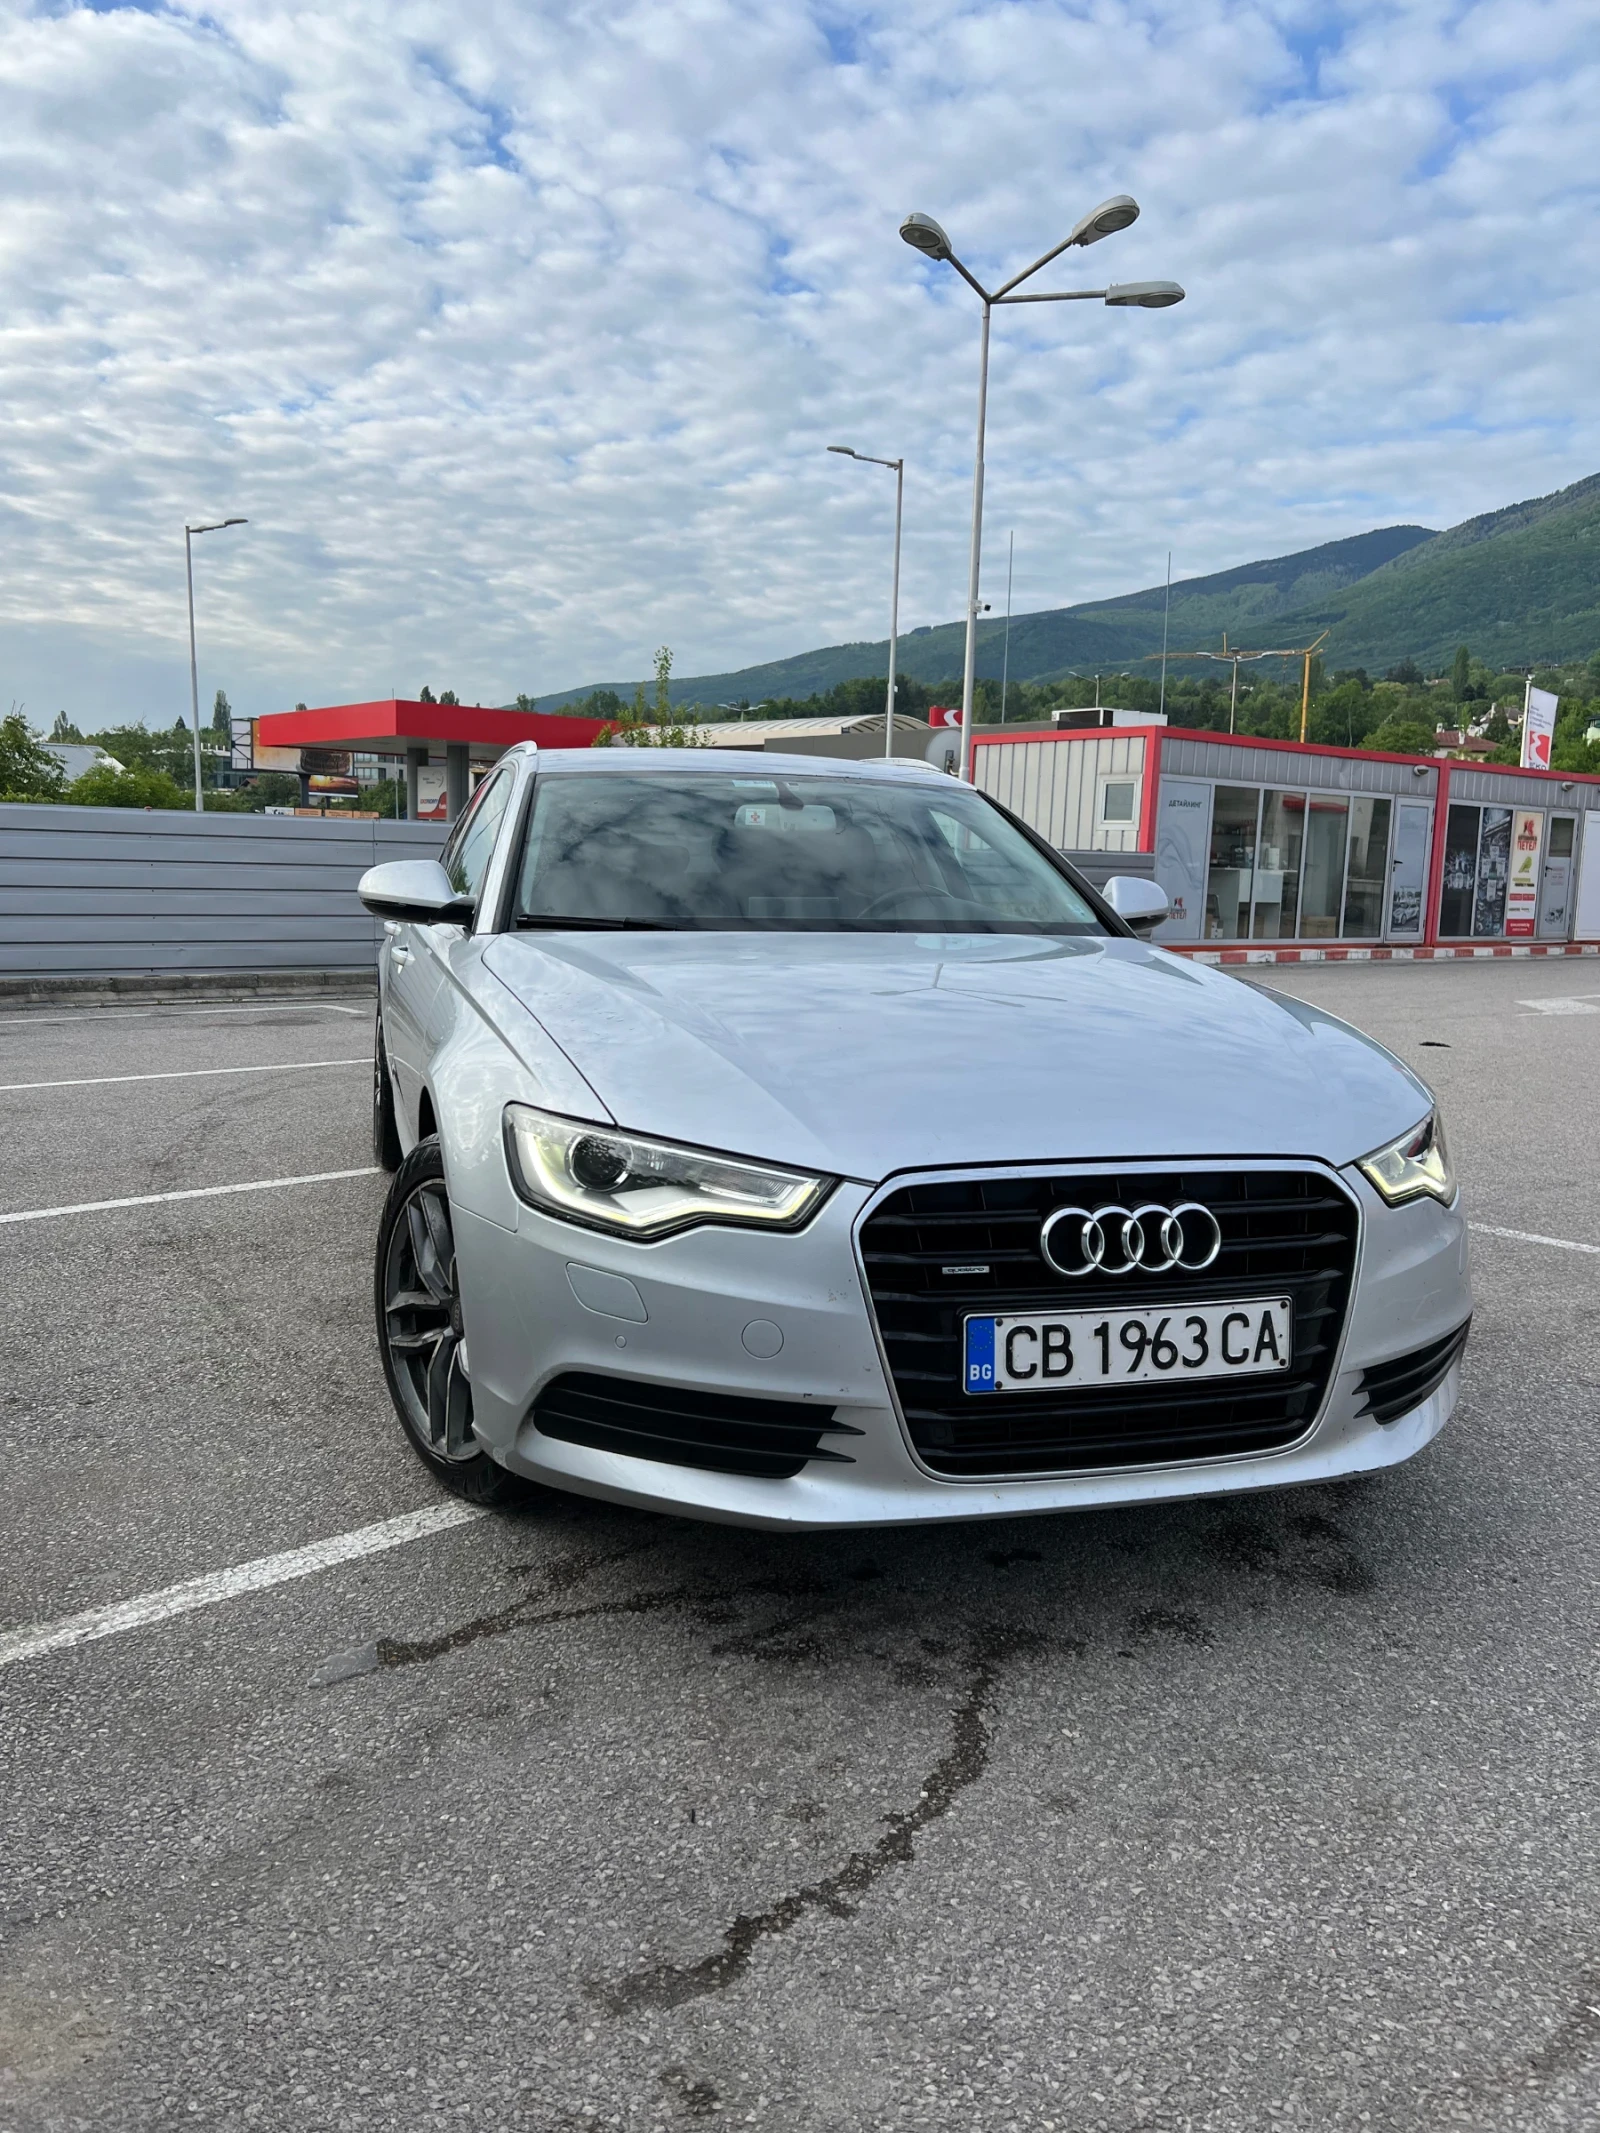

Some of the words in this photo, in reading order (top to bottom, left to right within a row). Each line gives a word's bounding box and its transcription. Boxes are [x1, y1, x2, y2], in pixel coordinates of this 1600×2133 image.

[1168, 799, 1202, 809] ДЕТАЙЛИНГ
[1517, 840, 1537, 851] ПЕТЕЛ
[947, 1267, 985, 1275] quattro
[1005, 1324, 1074, 1380] CB
[1094, 1315, 1209, 1375] 1963
[1221, 1310, 1280, 1364] CA
[969, 1364, 992, 1381] BG
